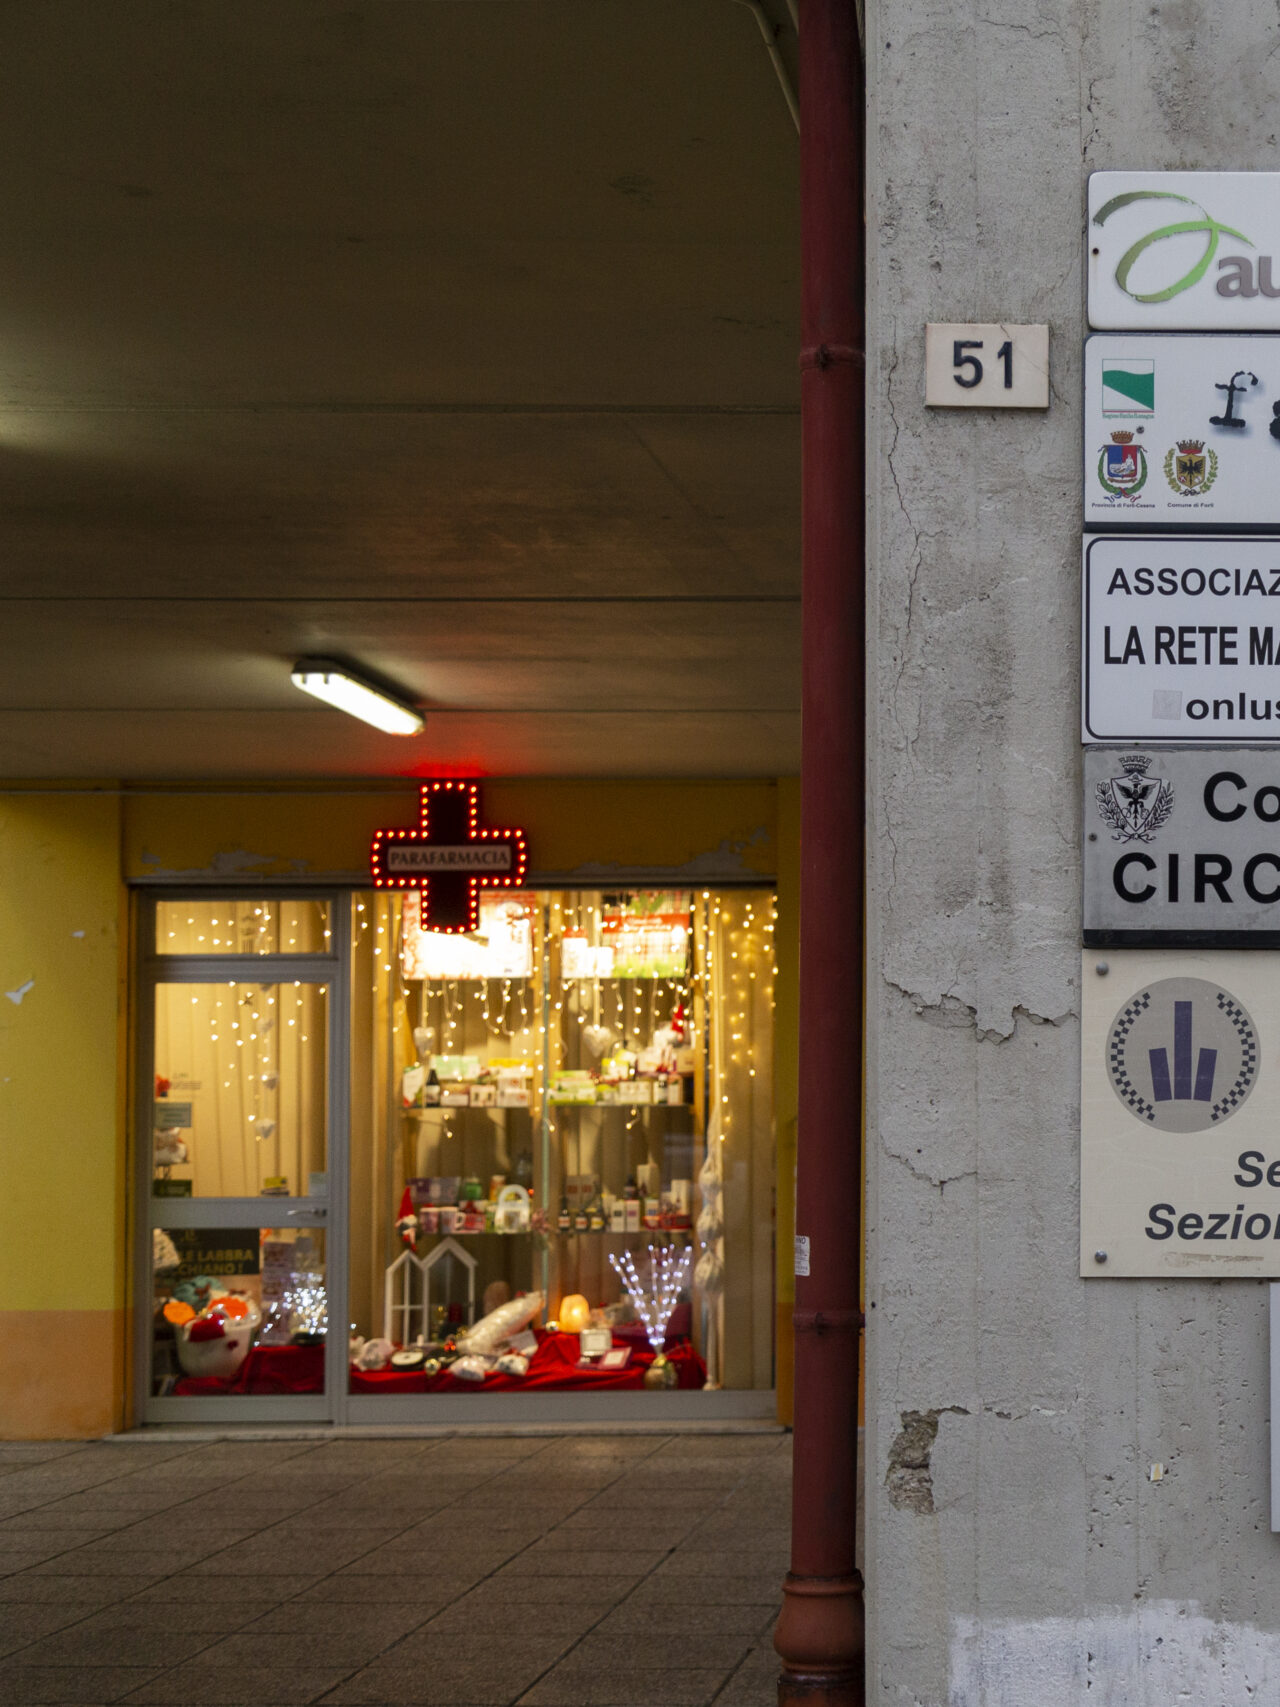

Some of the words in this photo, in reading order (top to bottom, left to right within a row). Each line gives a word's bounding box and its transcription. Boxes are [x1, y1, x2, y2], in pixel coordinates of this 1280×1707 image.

[954, 341, 1012, 389] 51
[1105, 626, 1145, 664] LA
[1155, 626, 1238, 665] RETE
[390, 851, 510, 866] PARAFARMACIA
